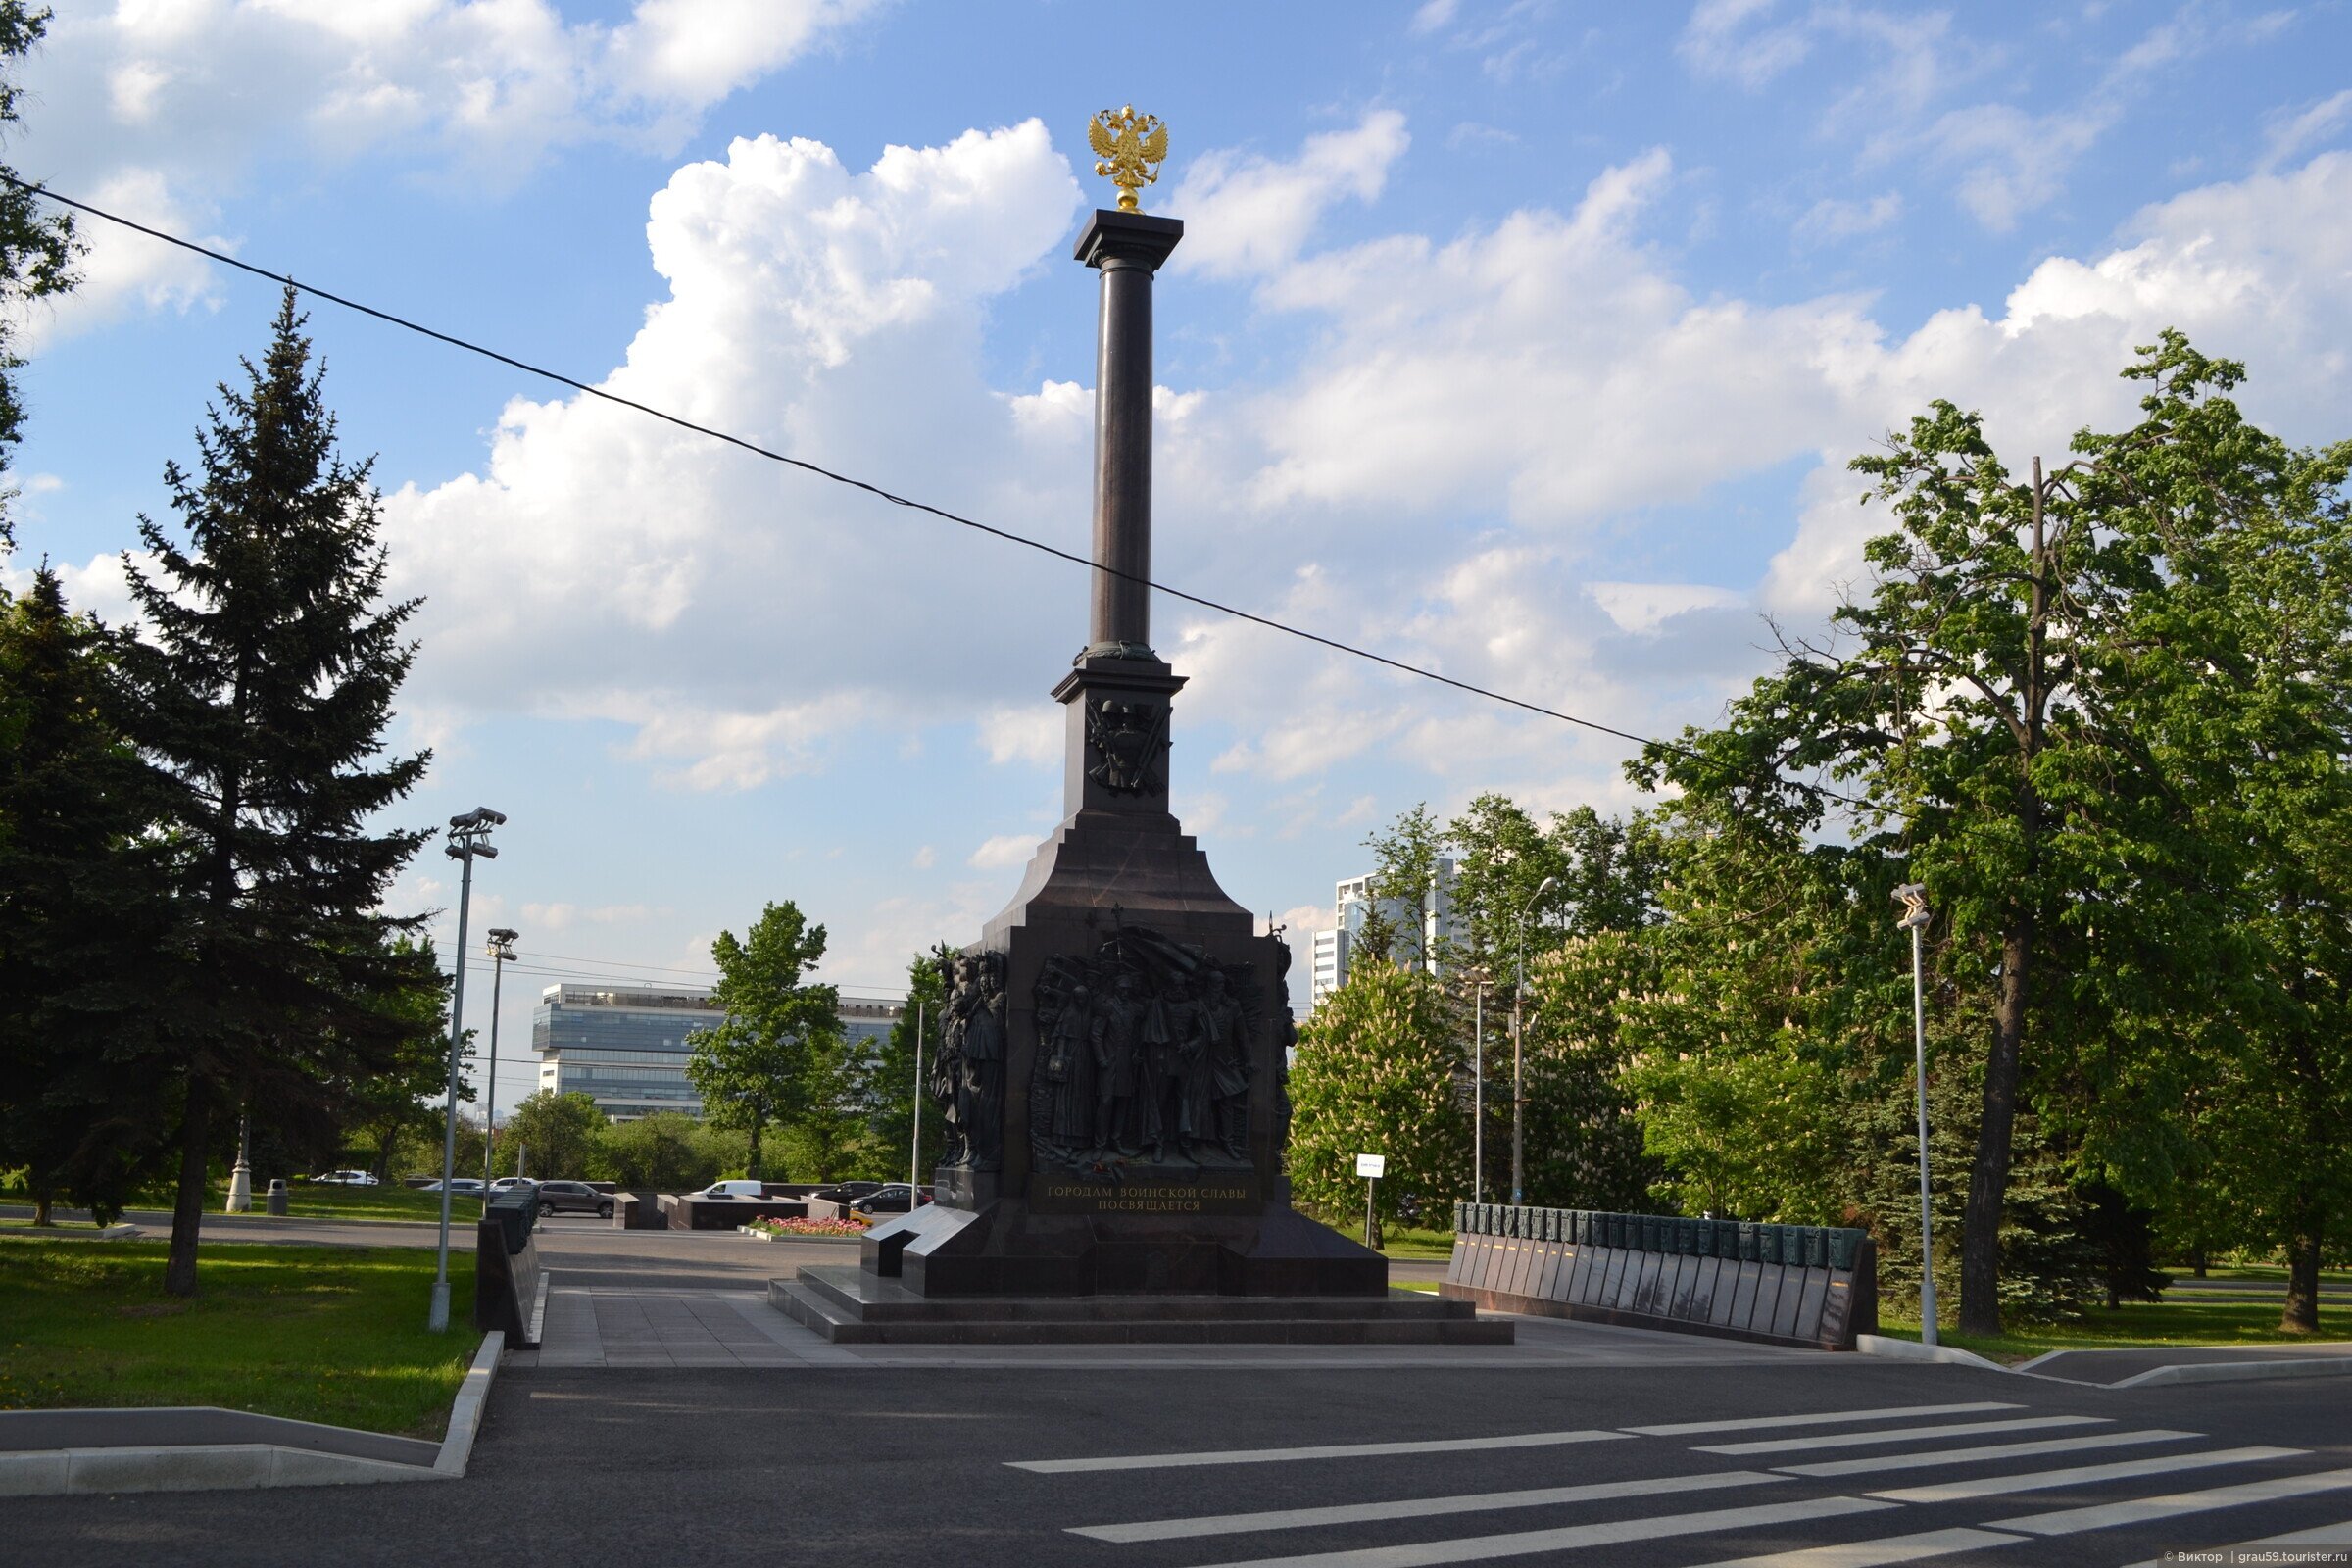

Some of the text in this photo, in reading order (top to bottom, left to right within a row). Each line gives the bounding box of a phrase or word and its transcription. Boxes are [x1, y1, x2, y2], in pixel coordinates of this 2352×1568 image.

[1048, 1185, 1246, 1199] ГОРОДАМ ВОИНСКОЙ СЛАВЫ
[1098, 1200, 1200, 1211] ПОСВЯЩАЕТСЯ
